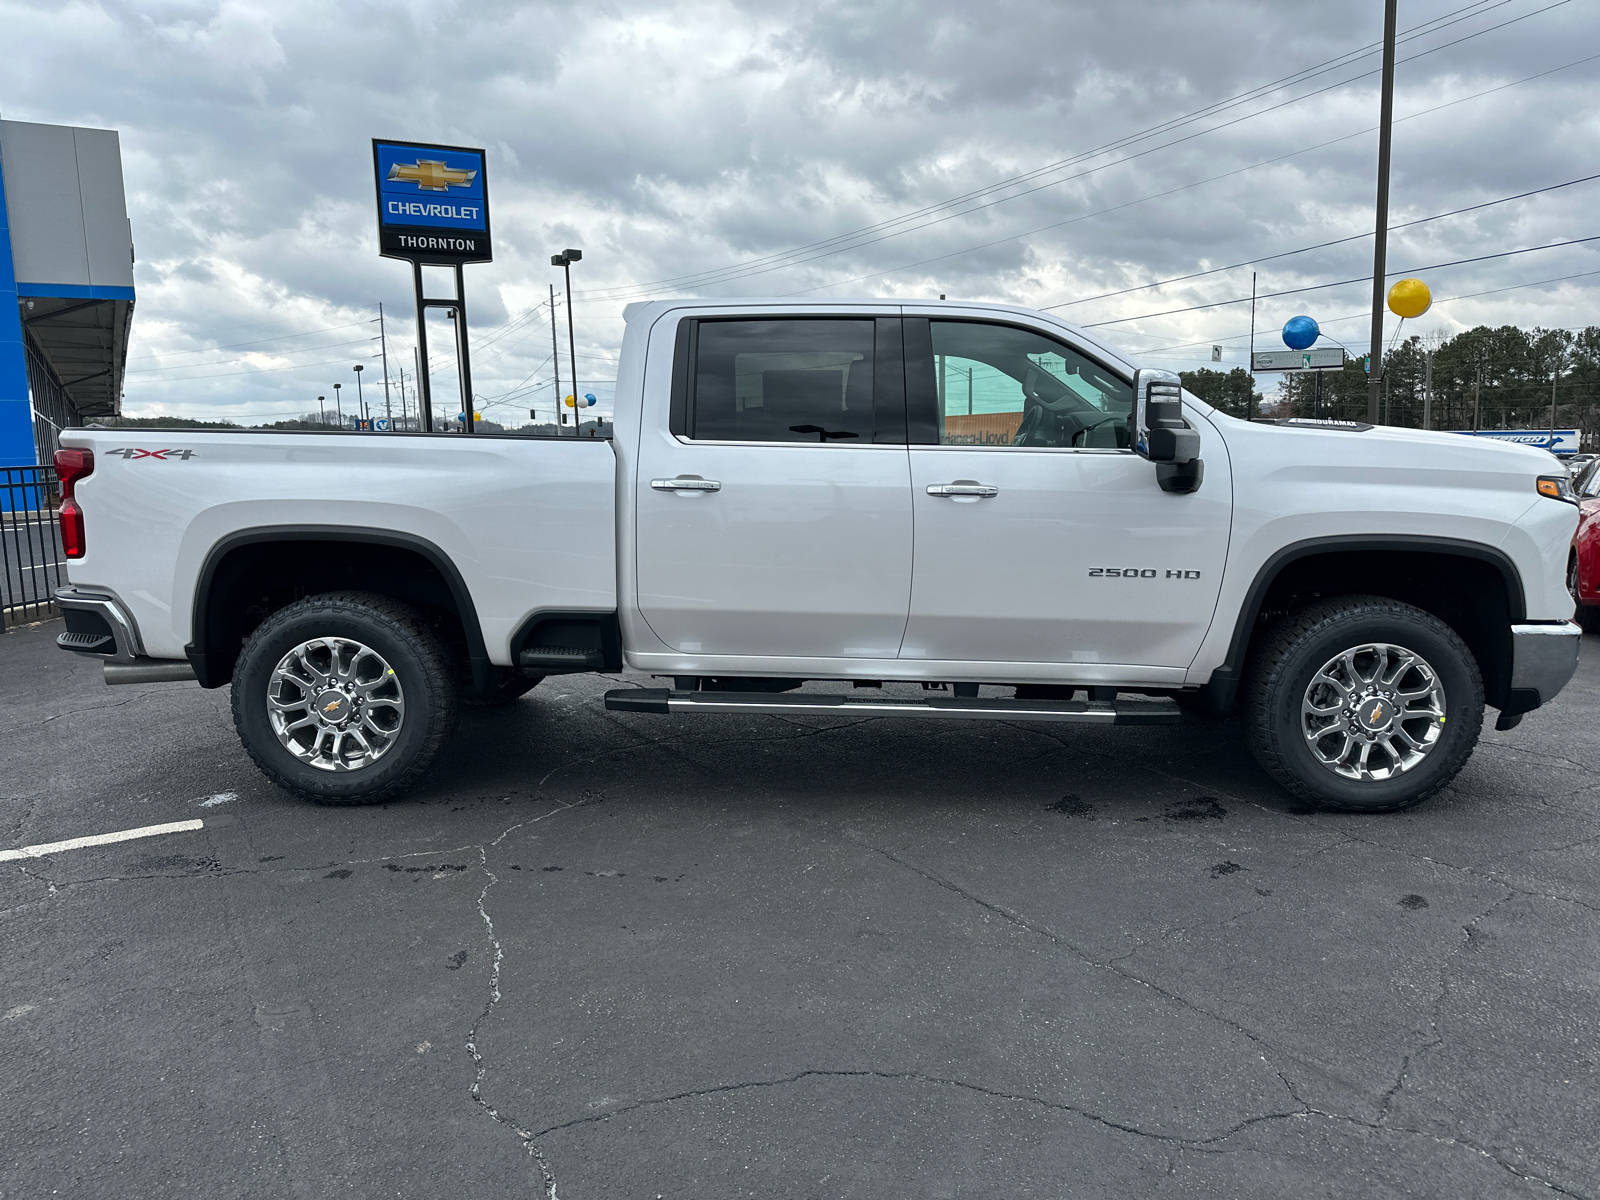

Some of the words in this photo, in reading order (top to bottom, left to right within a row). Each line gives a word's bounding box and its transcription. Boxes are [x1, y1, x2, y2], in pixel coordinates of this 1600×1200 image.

[388, 201, 479, 220] CHEVROLET
[398, 235, 475, 251] THORNTON
[1316, 419, 1357, 427] DURAMAX
[1088, 567, 1157, 578] 2500
[1165, 568, 1201, 580] HD
